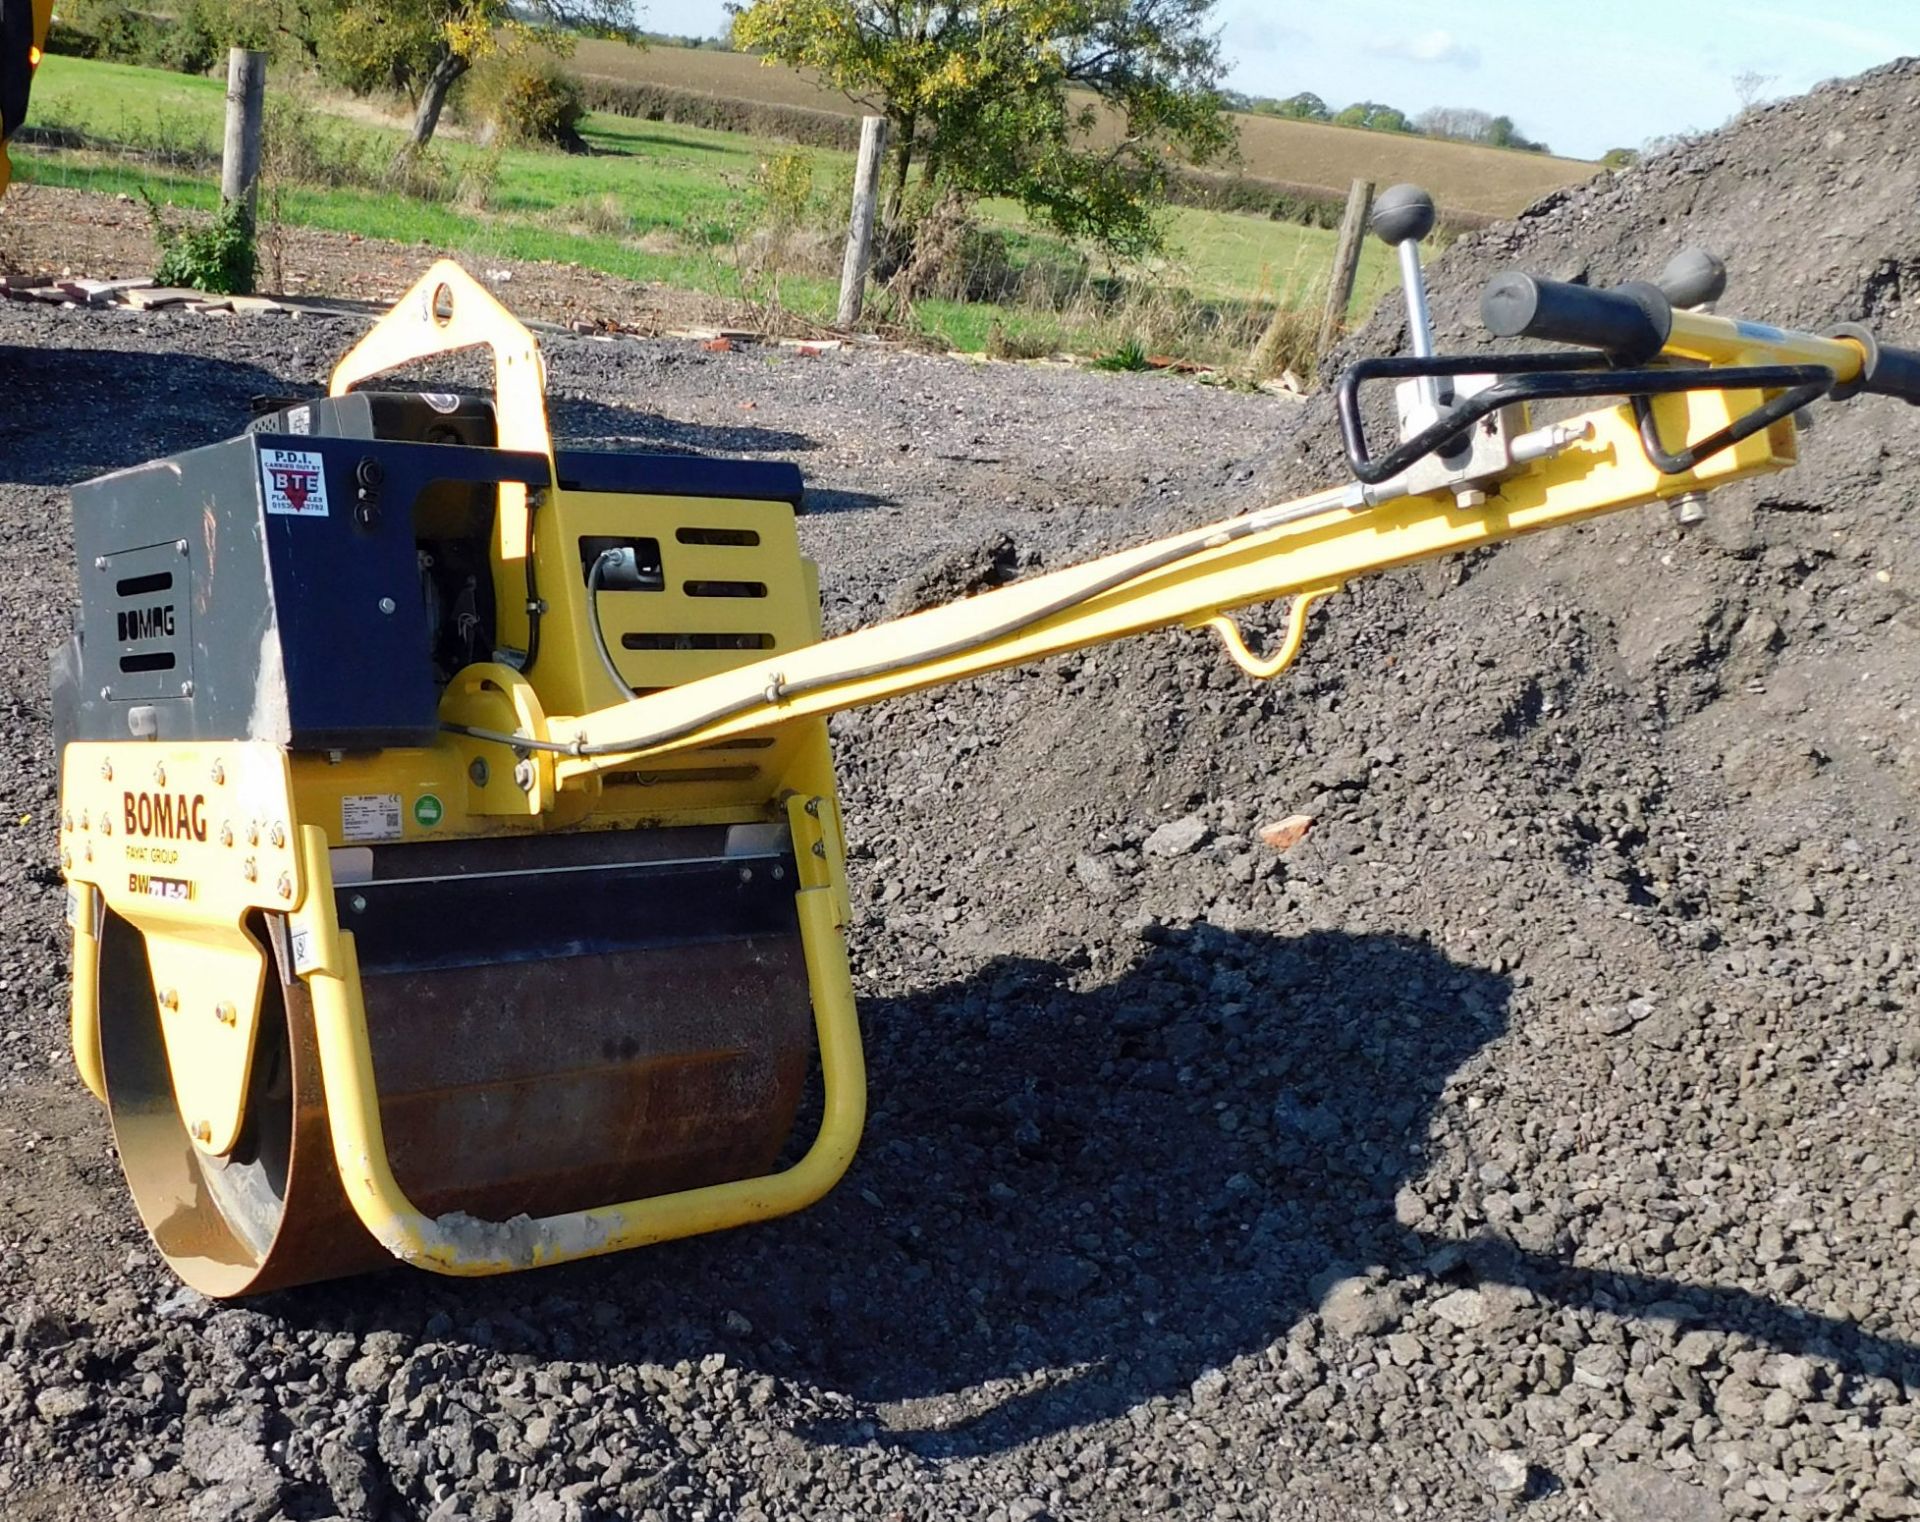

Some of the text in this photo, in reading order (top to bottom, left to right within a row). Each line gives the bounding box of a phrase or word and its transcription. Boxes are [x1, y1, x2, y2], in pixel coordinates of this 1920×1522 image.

[275, 451, 312, 464] P.D.I.
[275, 473, 318, 491] BTE
[117, 605, 175, 642] BOMAG
[123, 791, 207, 842] BOMAG
[126, 845, 178, 865] FAYAT GROUP
